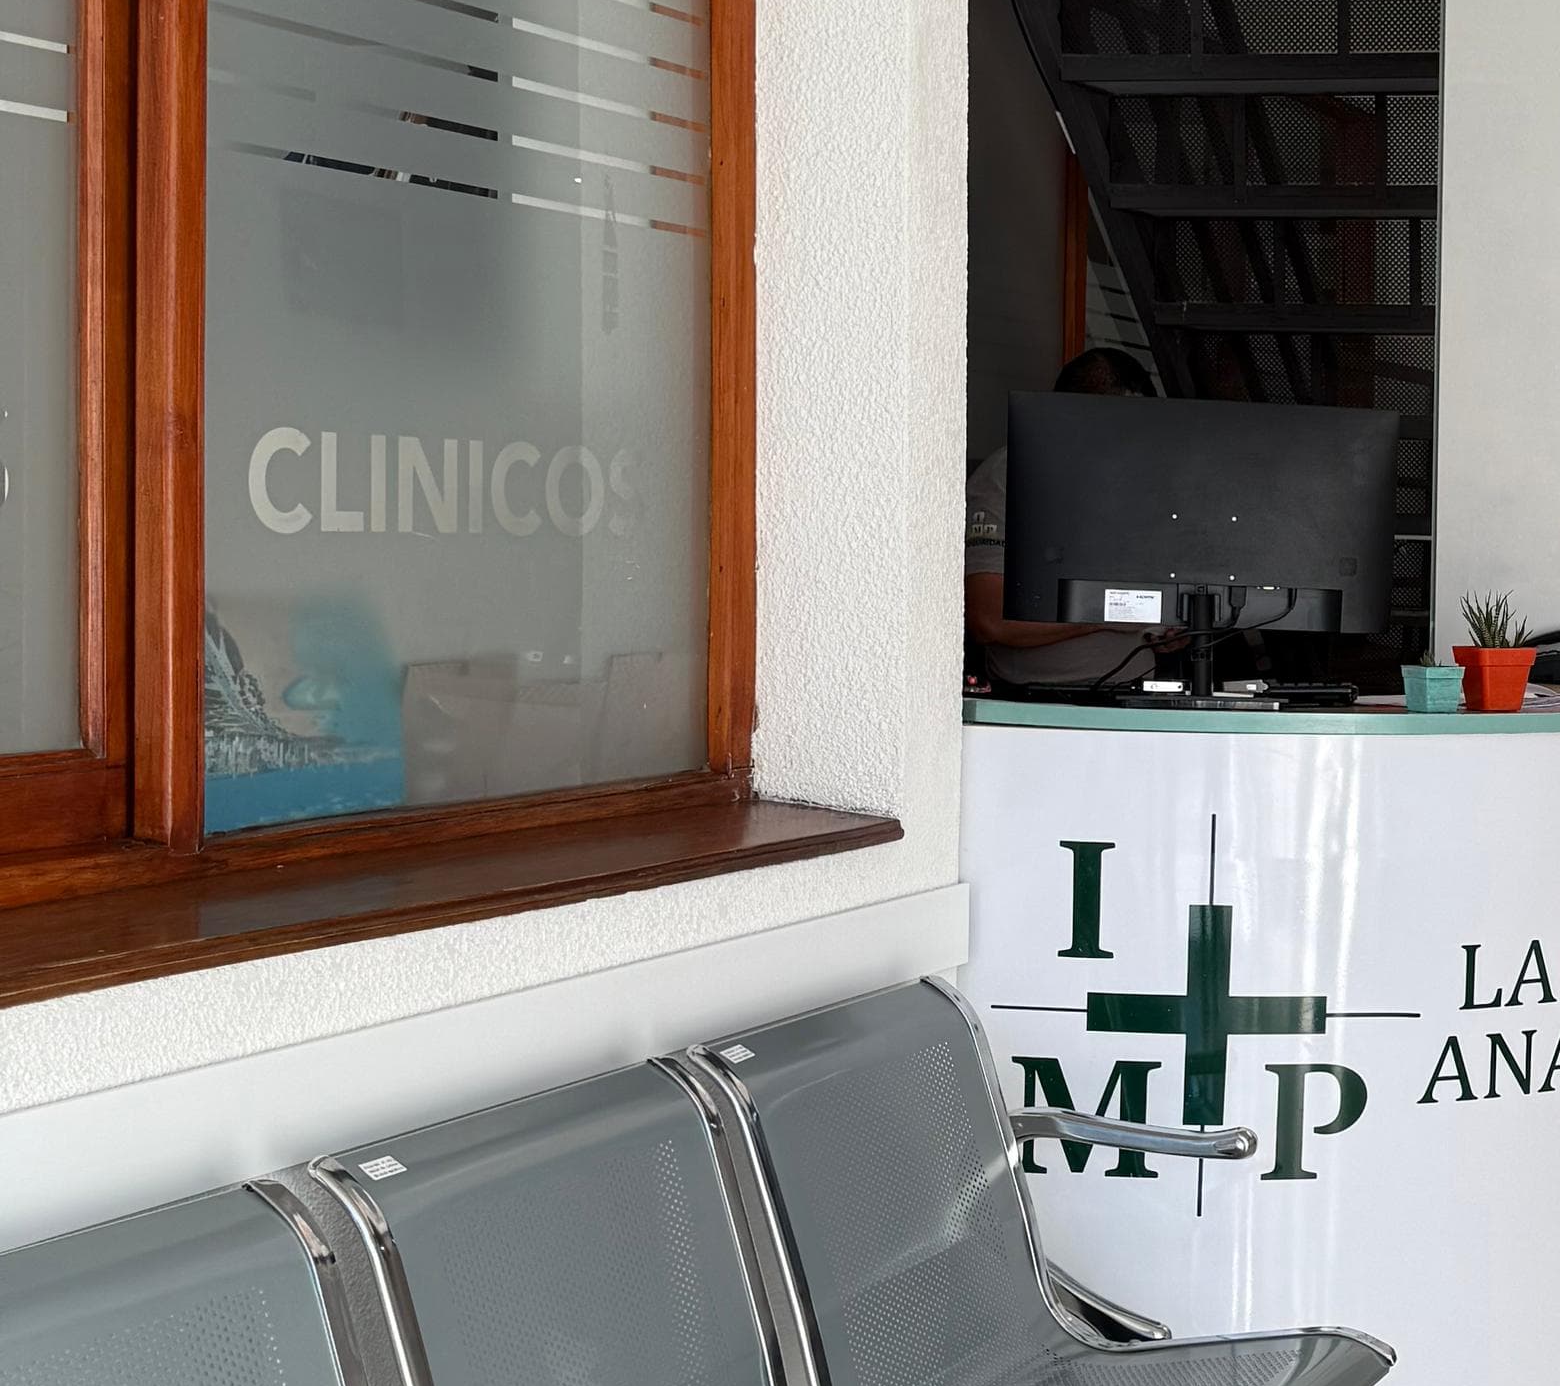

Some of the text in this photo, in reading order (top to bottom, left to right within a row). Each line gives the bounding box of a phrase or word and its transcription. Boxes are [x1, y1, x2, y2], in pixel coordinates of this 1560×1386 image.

[248, 426, 646, 539] CLINICOS
[1056, 840, 1116, 959] I
[1012, 1055, 1368, 1181] M P
